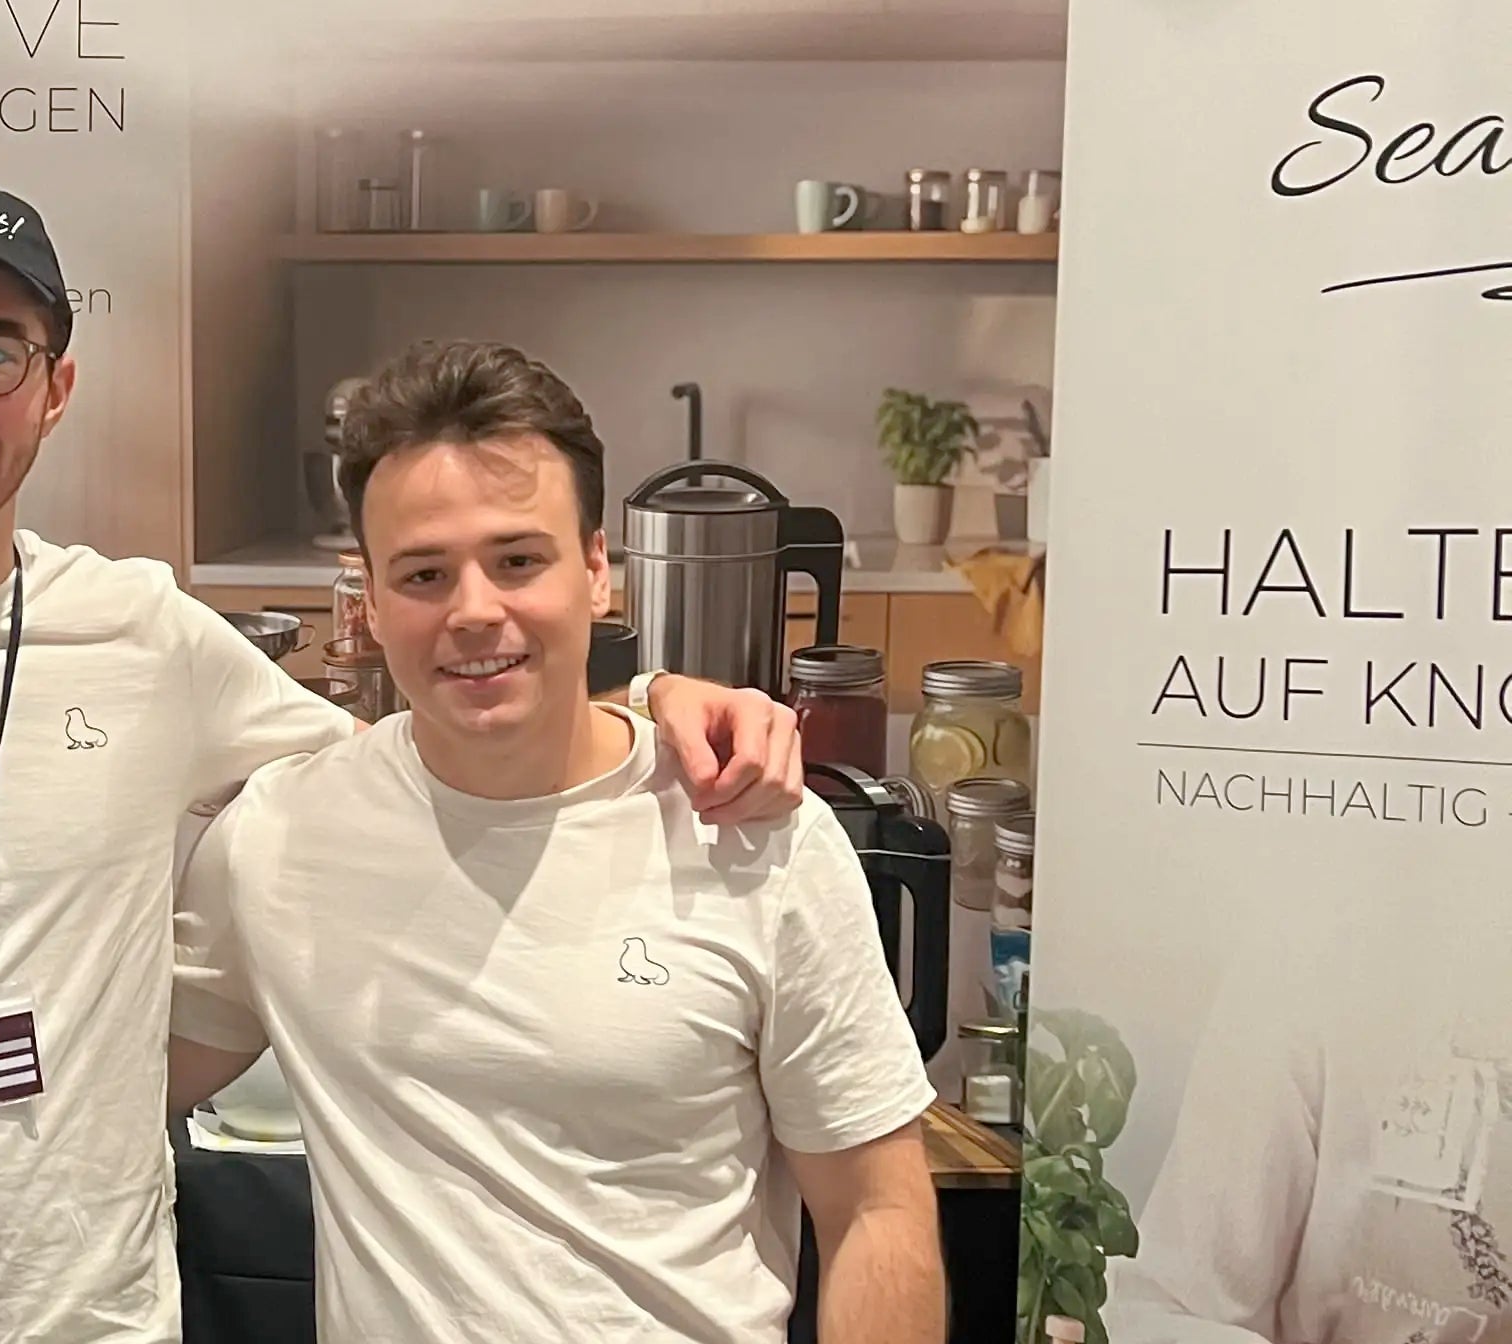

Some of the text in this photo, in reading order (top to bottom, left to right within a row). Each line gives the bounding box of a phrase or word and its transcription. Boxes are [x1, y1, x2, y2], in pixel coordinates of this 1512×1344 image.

[1271, 74, 1512, 197] Sea
[1151, 655, 1512, 730] AUF KN
[1157, 768, 1487, 827] NACHHALTIG
